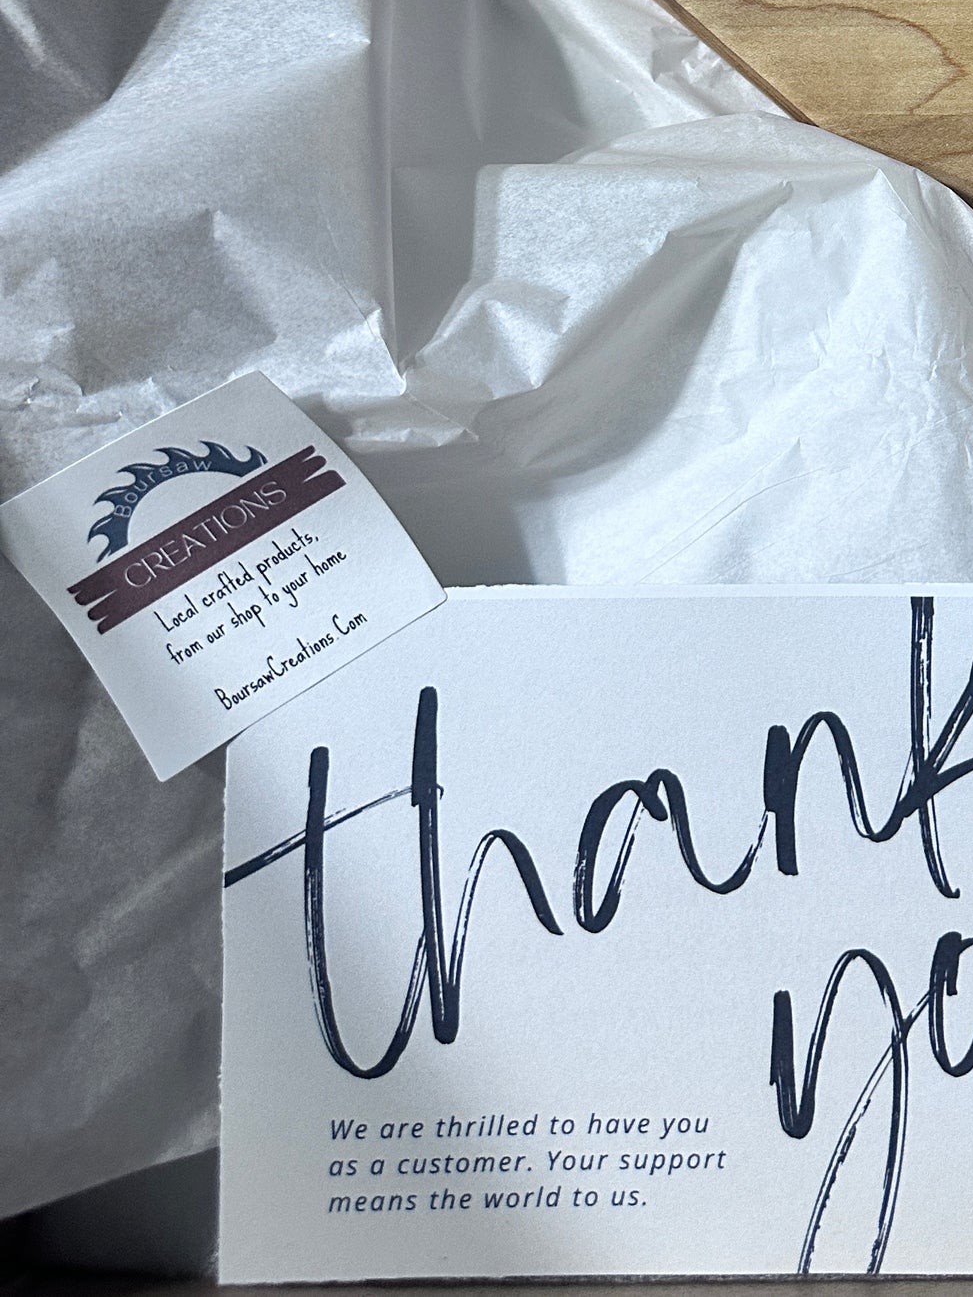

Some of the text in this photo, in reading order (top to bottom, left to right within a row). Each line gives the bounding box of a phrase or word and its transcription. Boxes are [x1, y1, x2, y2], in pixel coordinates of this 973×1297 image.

[114, 457, 214, 518] Boursaw
[125, 480, 288, 589] CREATIONS
[154, 527, 320, 632] Local crafted products,
[166, 550, 347, 665] from our shop to your home
[330, 1113, 709, 1140] We are thrilled to have you
[329, 1149, 727, 1176] as a customer. Your support
[328, 1186, 648, 1213] means the world to us.
